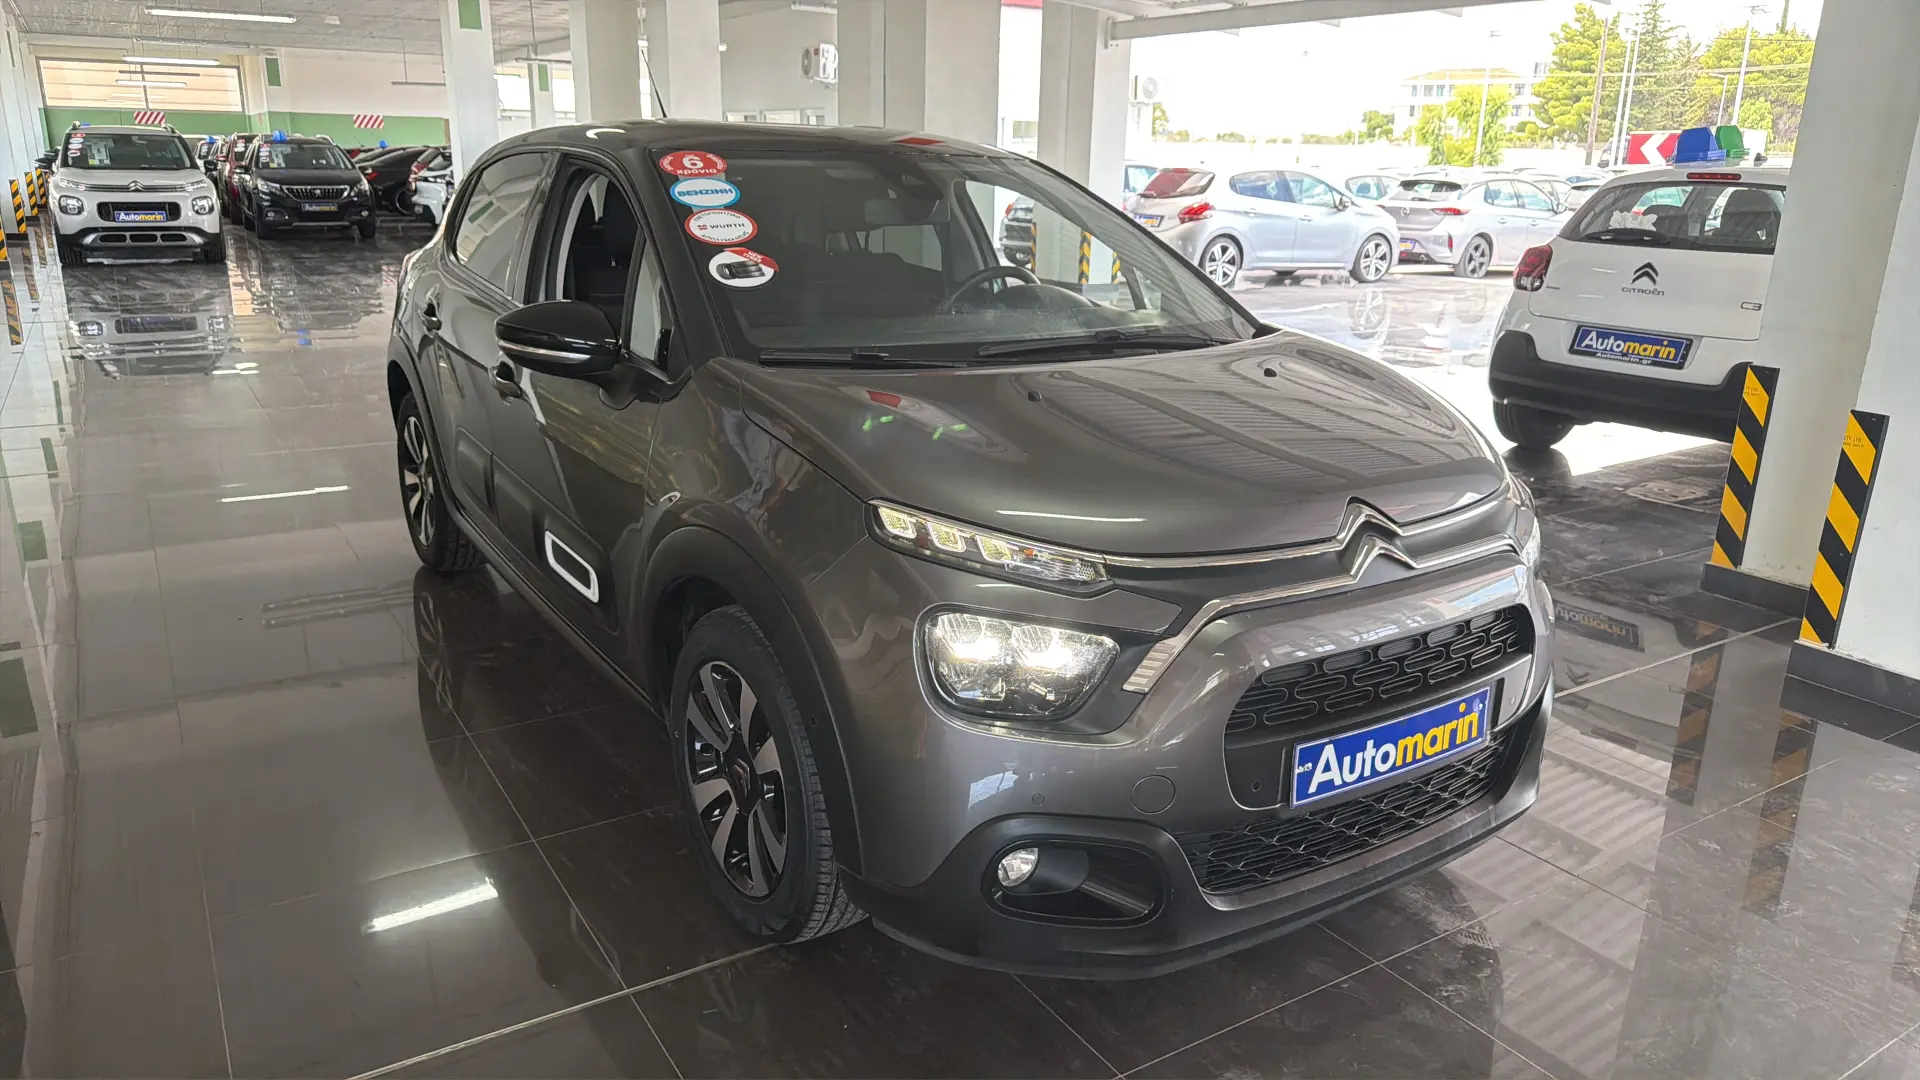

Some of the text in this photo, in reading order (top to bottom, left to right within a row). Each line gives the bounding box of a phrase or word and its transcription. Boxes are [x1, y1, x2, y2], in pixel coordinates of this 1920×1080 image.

[682, 156, 704, 169] 6
[119, 211, 163, 221] Automarin
[1740, 301, 1762, 311] C3
[1581, 331, 1676, 359] Automarin
[1596, 352, 1652, 365] Automarin.gr
[1308, 702, 1479, 794] Automarin
